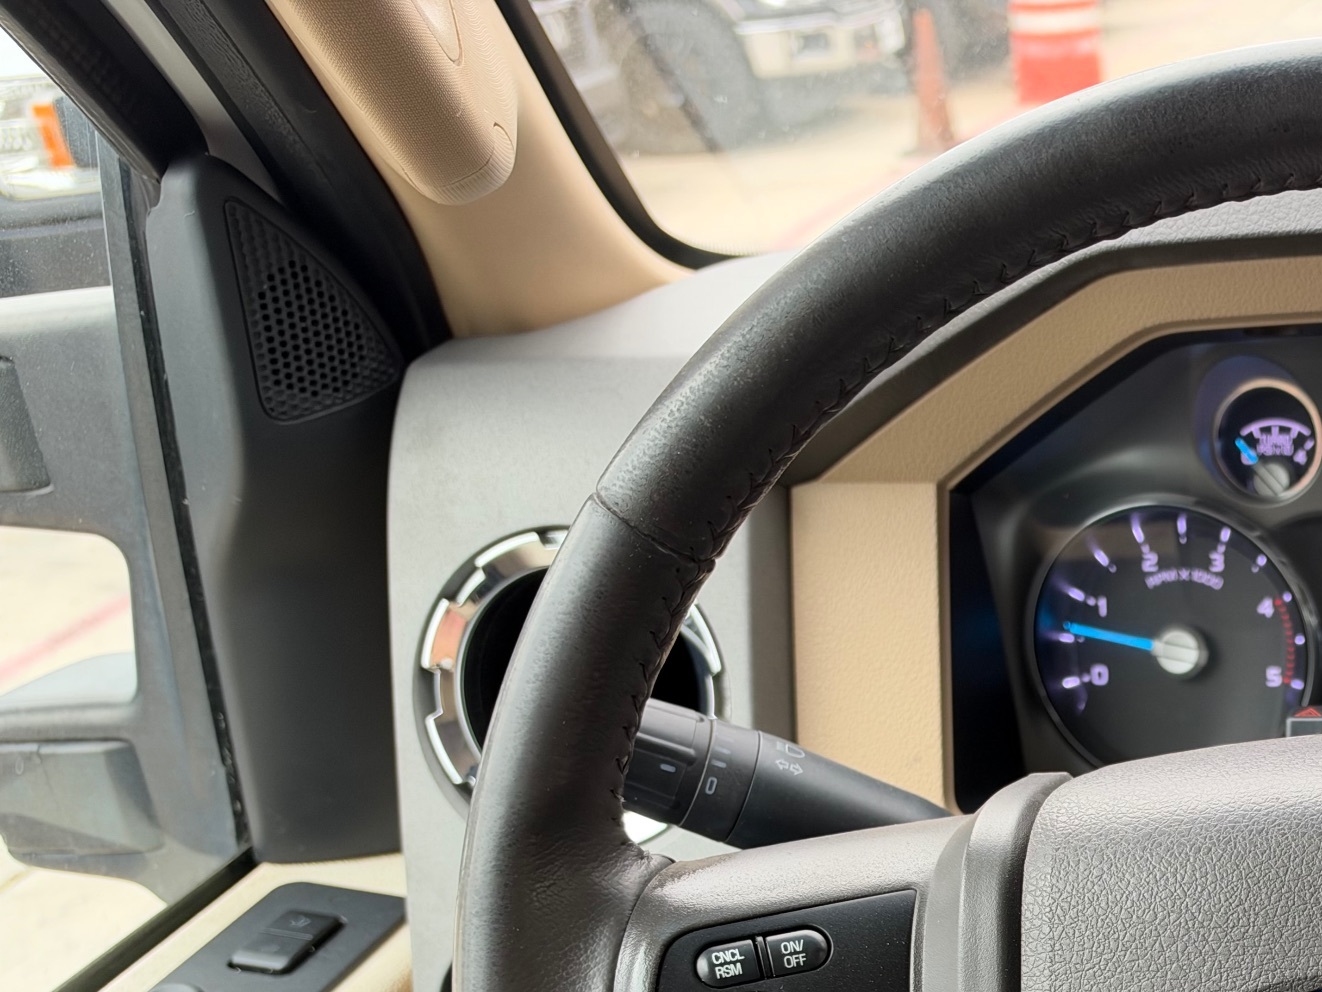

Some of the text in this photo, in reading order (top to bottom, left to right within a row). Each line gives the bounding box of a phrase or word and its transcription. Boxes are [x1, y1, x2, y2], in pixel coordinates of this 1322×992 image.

[1141, 551, 1159, 573] 2
[1208, 551, 1225, 573] 3
[1097, 595, 1108, 617] 1
[1257, 597, 1274, 618] 4
[1090, 664, 1109, 686] 0
[1265, 666, 1282, 688] 5
[711, 949, 745, 965] CNCL
[780, 940, 804, 955] ON/
[715, 963, 743, 979] RSM
[783, 953, 807, 969] OFF
